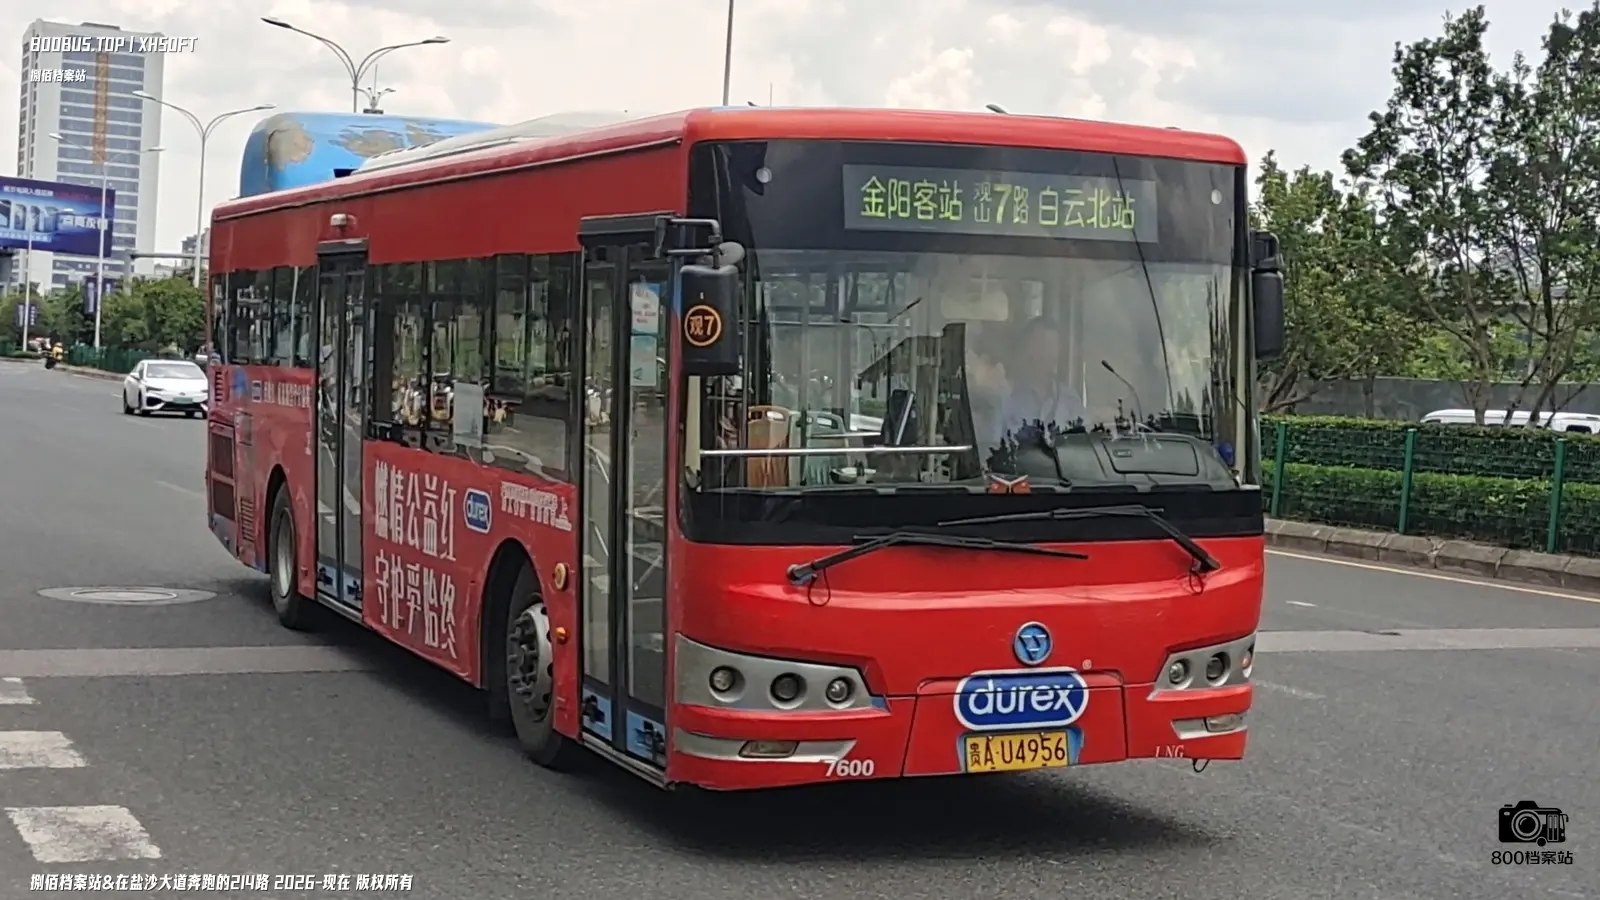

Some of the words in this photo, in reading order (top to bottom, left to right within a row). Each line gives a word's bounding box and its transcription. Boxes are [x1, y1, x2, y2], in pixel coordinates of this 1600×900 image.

[860, 175, 963, 220] 金阳客站
[1038, 186, 1135, 229] 白云北站
[689, 315, 715, 336] 观7
[375, 460, 457, 562] 燃情公益红
[466, 494, 490, 528] durex
[968, 679, 1077, 716] durex
[824, 759, 875, 777] 7600
